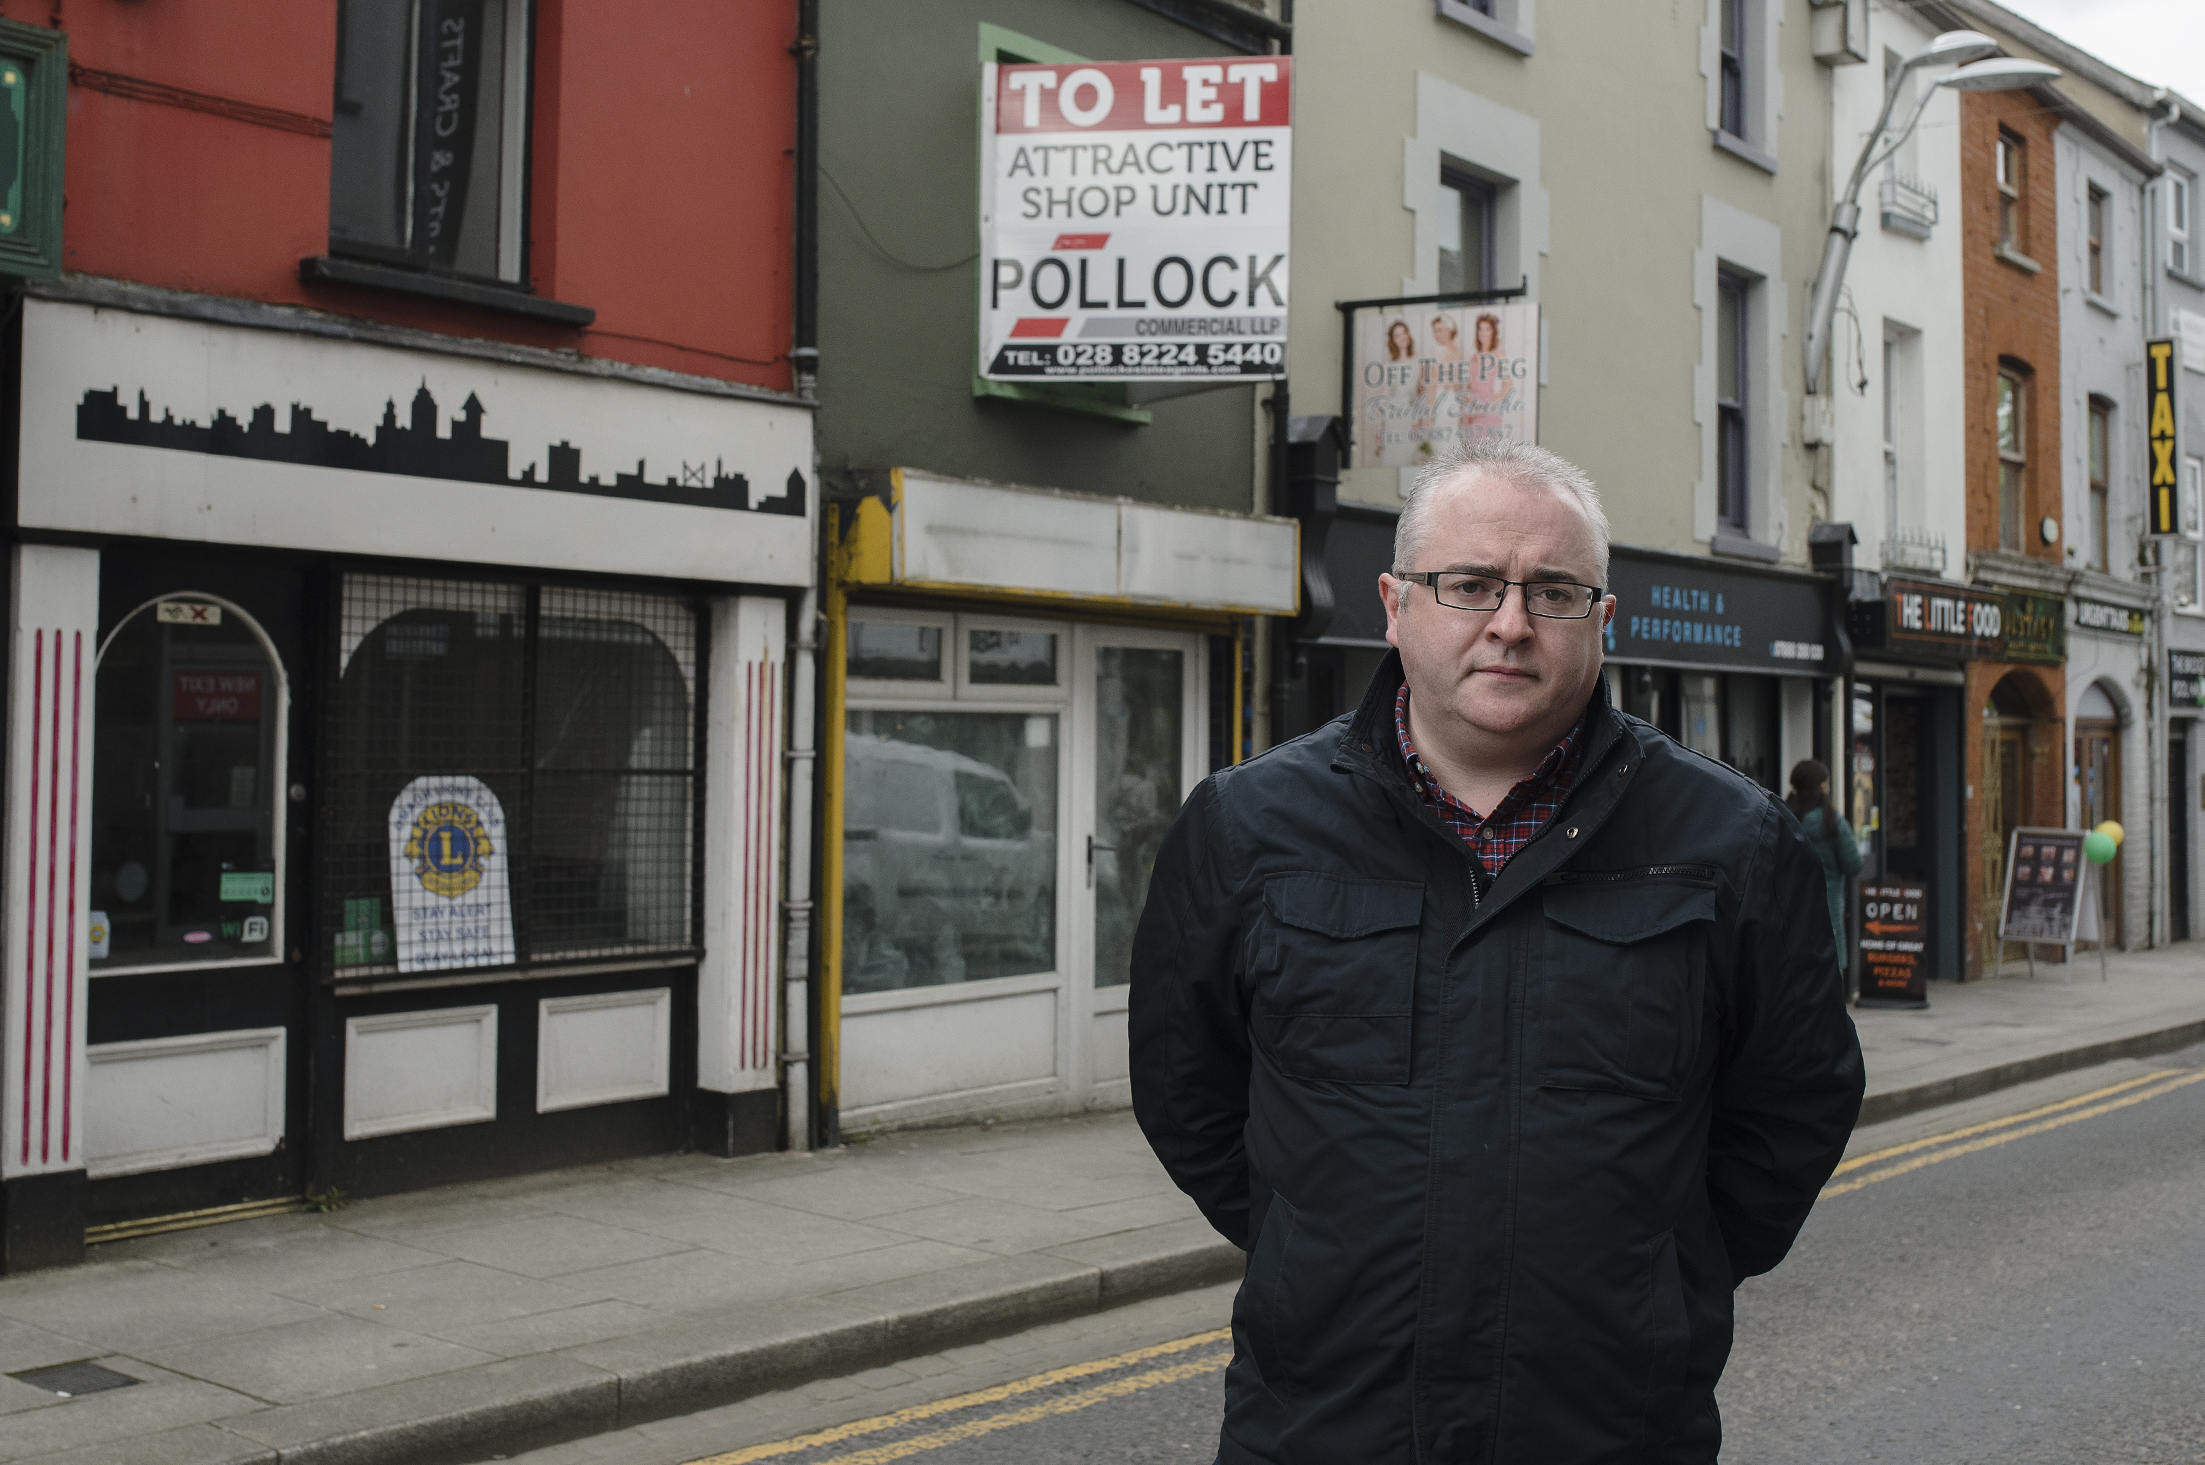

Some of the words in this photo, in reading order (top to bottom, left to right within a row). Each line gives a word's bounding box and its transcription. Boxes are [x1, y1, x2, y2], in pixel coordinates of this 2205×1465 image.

[1008, 68, 1115, 128] TO
[1140, 63, 1279, 124] LET
[1007, 140, 1275, 178] ATTRACTIVE
[1022, 185, 1137, 219] SHOP
[1149, 182, 1258, 217] UNIT
[991, 254, 1286, 311] POLLOCK
[1134, 318, 1247, 337] COMMERCIAL
[1251, 317, 1281, 336] LLP
[1004, 350, 1052, 367] TEL:
[1056, 344, 1113, 367] 028
[1121, 344, 1199, 366] 8224
[1206, 343, 1282, 365] 5440
[2150, 343, 2176, 533] TAXI
[1651, 585, 1710, 612] HEALTH
[1714, 592, 1725, 615] &
[1896, 593, 1922, 630] THE
[1923, 597, 1966, 635] LITTLE
[1966, 602, 2001, 638] FOOD
[1630, 615, 1742, 648] PERFORMANCE
[421, 805, 474, 826] LIONS
[439, 831, 464, 866] L
[413, 906, 445, 921] STAY
[449, 903, 491, 918] ALERT
[1865, 902, 1918, 921] OPEN
[456, 925, 490, 940] SAFE
